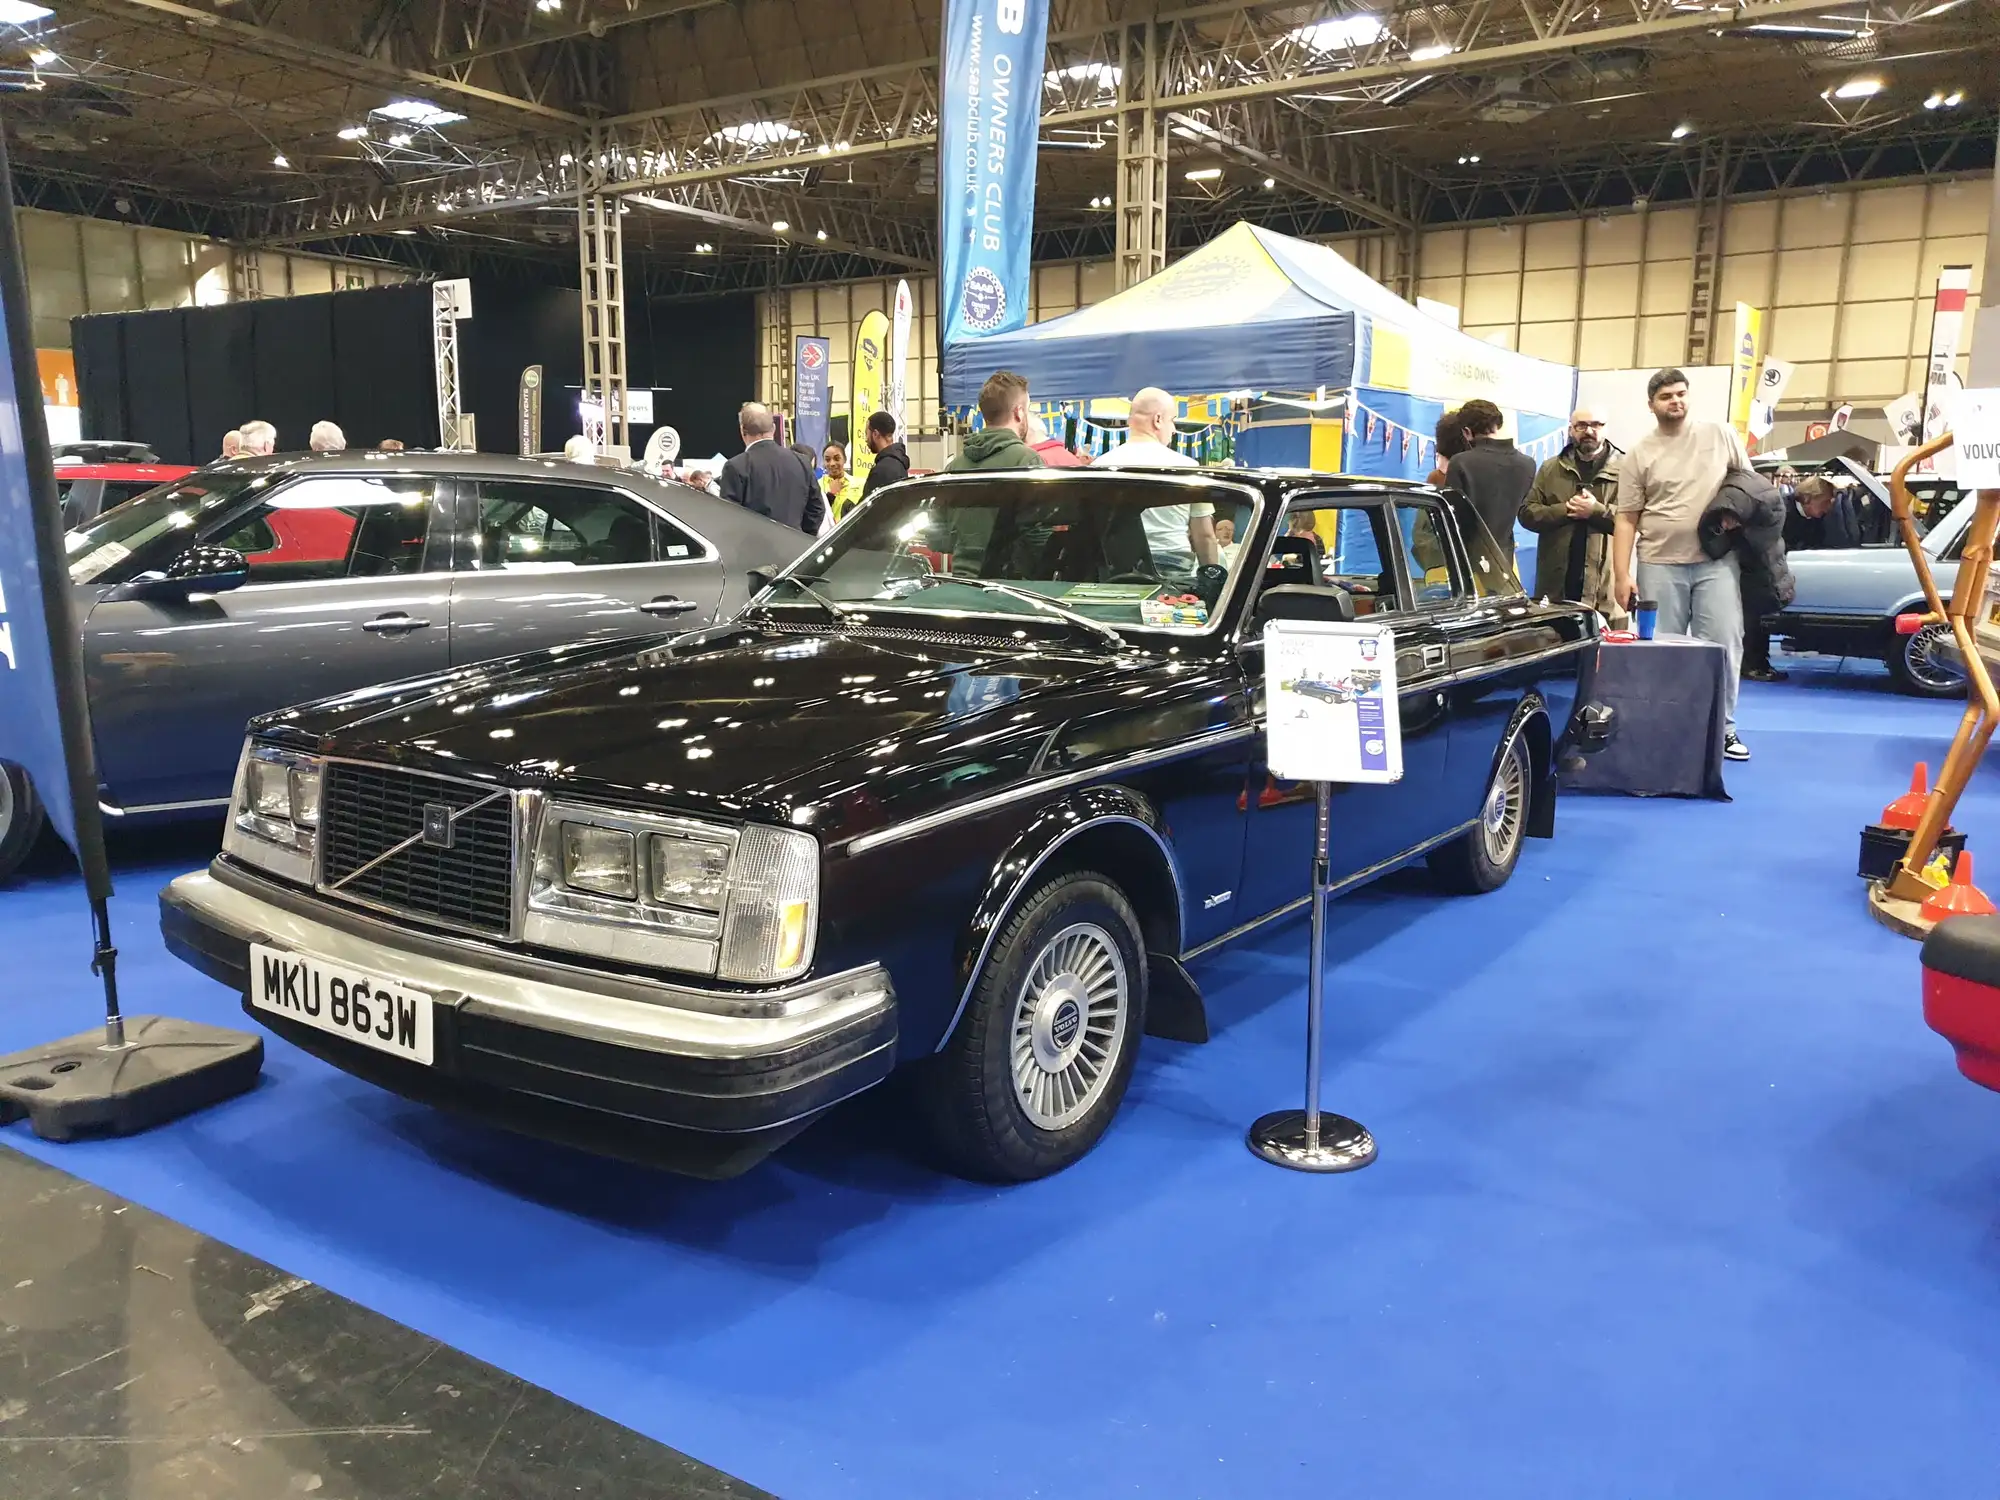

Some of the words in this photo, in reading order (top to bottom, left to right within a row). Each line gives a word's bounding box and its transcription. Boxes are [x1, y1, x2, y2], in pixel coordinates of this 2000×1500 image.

[966, 14, 984, 194] www.saabclub.co.uk
[988, 54, 1012, 175] OWNERS
[983, 182, 1003, 252] CLUB
[1474, 367, 1499, 384] OWNE
[263, 955, 320, 1017] MKU
[330, 977, 416, 1050] 863W
[1054, 1016, 1078, 1032] VOLVO
